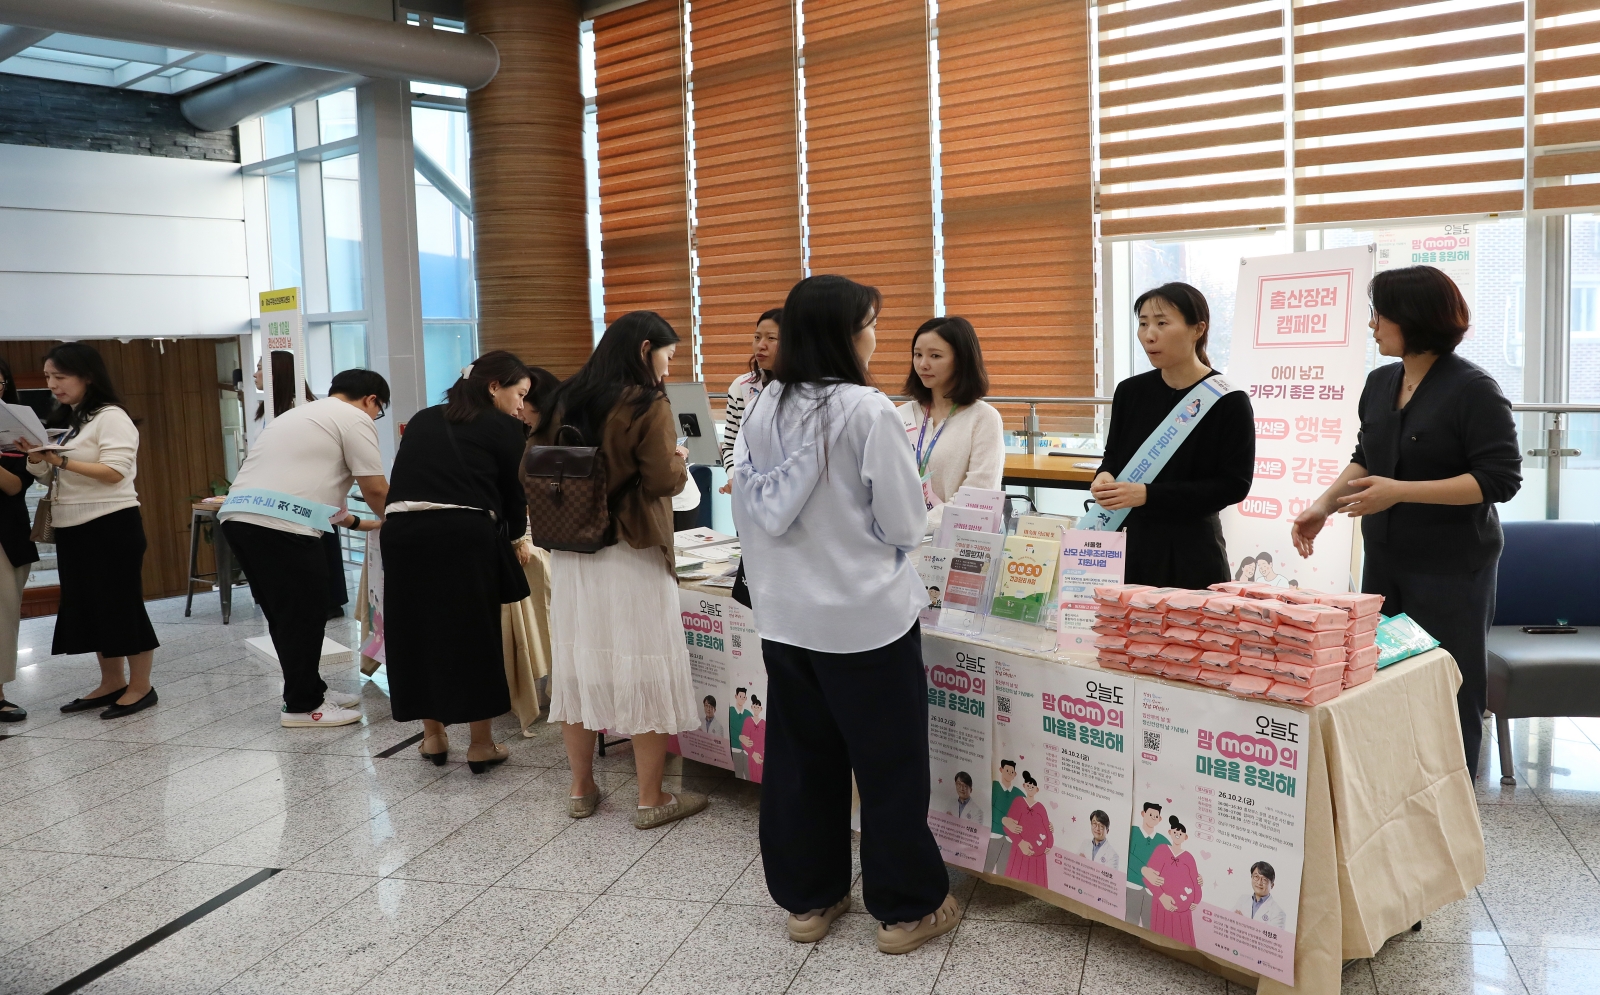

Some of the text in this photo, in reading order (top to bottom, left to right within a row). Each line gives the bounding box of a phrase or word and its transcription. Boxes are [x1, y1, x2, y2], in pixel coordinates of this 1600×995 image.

[1444, 224, 1470, 236] 오늘도
[1412, 239, 1422, 250] 맘
[1426, 239, 1454, 248] mom
[1458, 237, 1470, 248] 의
[1412, 251, 1469, 263] 마음을 응원해
[1270, 286, 1337, 310] 출산장려
[1276, 313, 1327, 335] 캠페인
[1271, 366, 1324, 381] 아이 낳고
[1250, 384, 1344, 401] 키우기 좋은 강남
[1295, 415, 1342, 444] 행복
[1292, 457, 1339, 486] 감동
[278, 500, 291, 512] 첫
[292, 504, 313, 518] 선물
[1242, 500, 1278, 515] 아이는
[1064, 548, 1122, 559] 산모 산후조리경비
[1078, 558, 1106, 567] 지원사업
[700, 600, 722, 617] 오늘도
[683, 616, 710, 630] mom
[713, 620, 723, 634] 의
[696, 633, 724, 652] 응원해
[956, 652, 986, 674] 오늘도
[934, 670, 985, 696] mom 의
[1086, 680, 1123, 705] 오늘도
[928, 687, 985, 718] 음을 응원해
[1042, 692, 1123, 728] 맘 mom 의
[1043, 715, 1076, 741] 마음을
[1079, 726, 1124, 753] 응원해
[1255, 715, 1299, 744] 오늘도
[1197, 729, 1298, 770] 맘 mom 의
[1196, 754, 1296, 797] 마음을 응원해
[1218, 791, 1254, 806] 26.10.2.(금)
